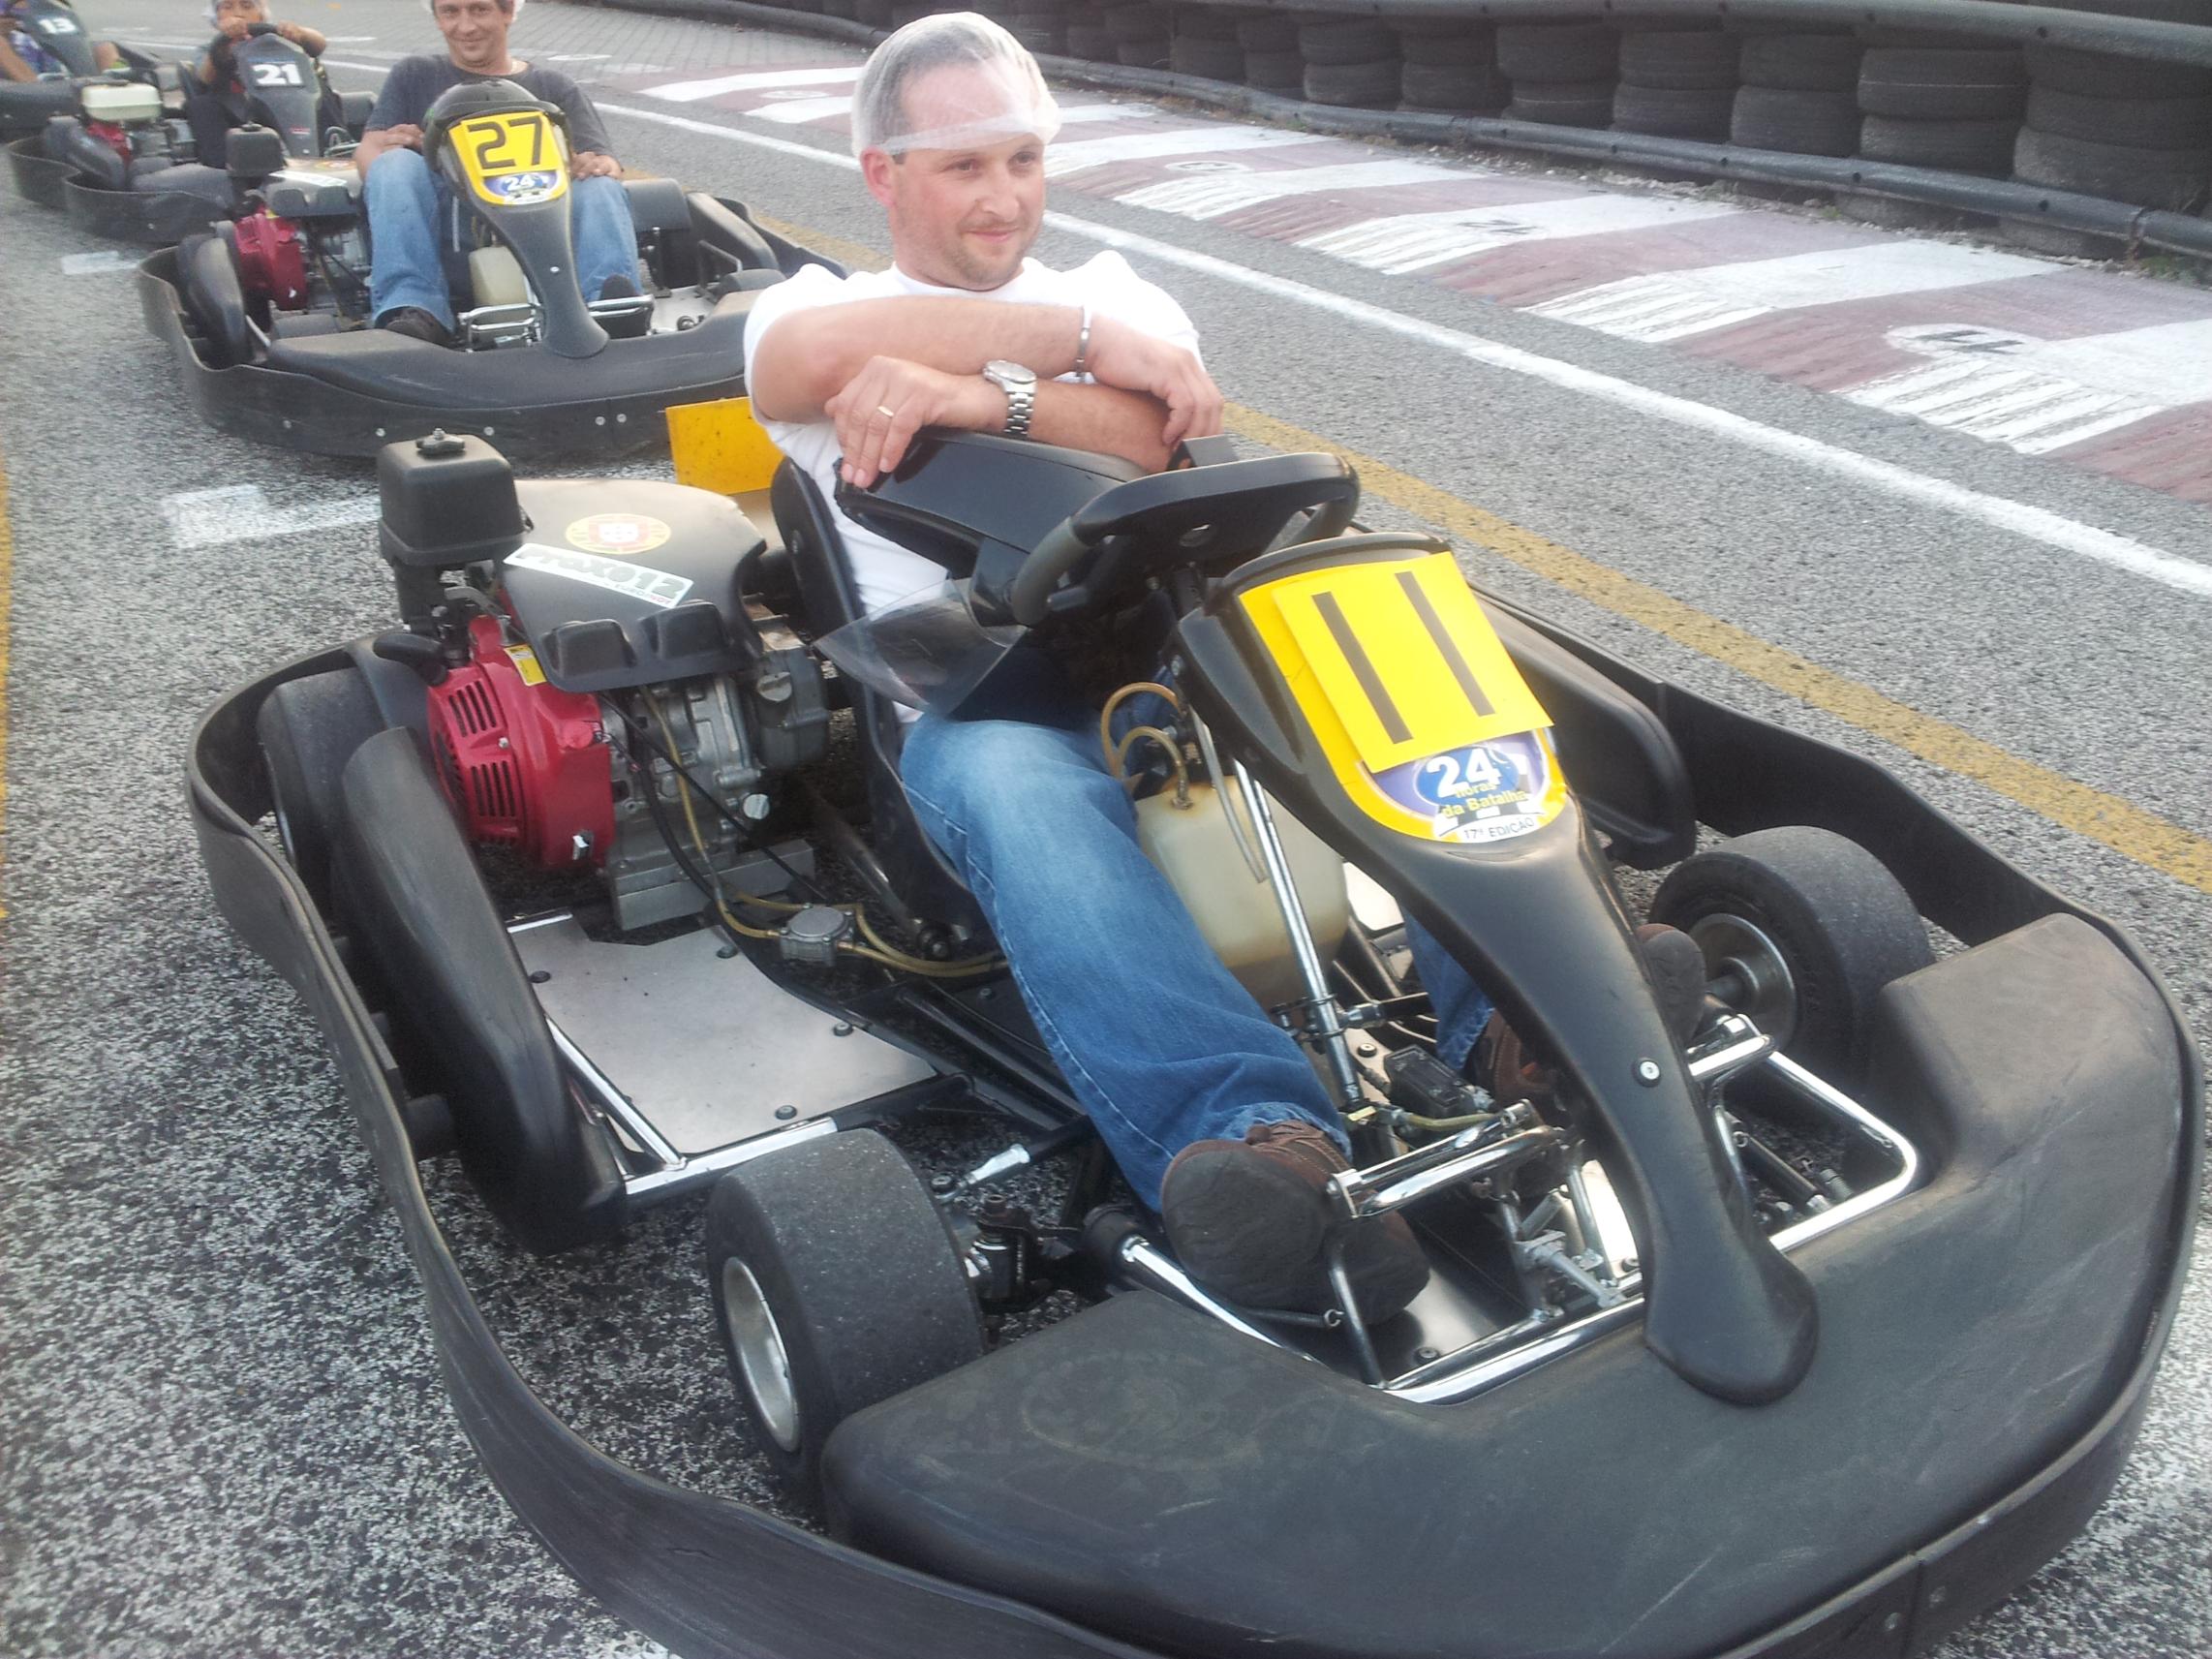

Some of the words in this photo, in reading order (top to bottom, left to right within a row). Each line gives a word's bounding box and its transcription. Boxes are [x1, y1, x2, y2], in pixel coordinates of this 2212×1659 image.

[38, 17, 77, 34] 13
[252, 63, 303, 86] 21
[467, 115, 543, 169] 27
[507, 174, 536, 193] 24
[1310, 570, 1496, 745] 11
[1426, 748, 1501, 798] 24
[1456, 782, 1497, 798] horas
[1440, 805, 1464, 819] da
[1466, 790, 1526, 811] Batalha
